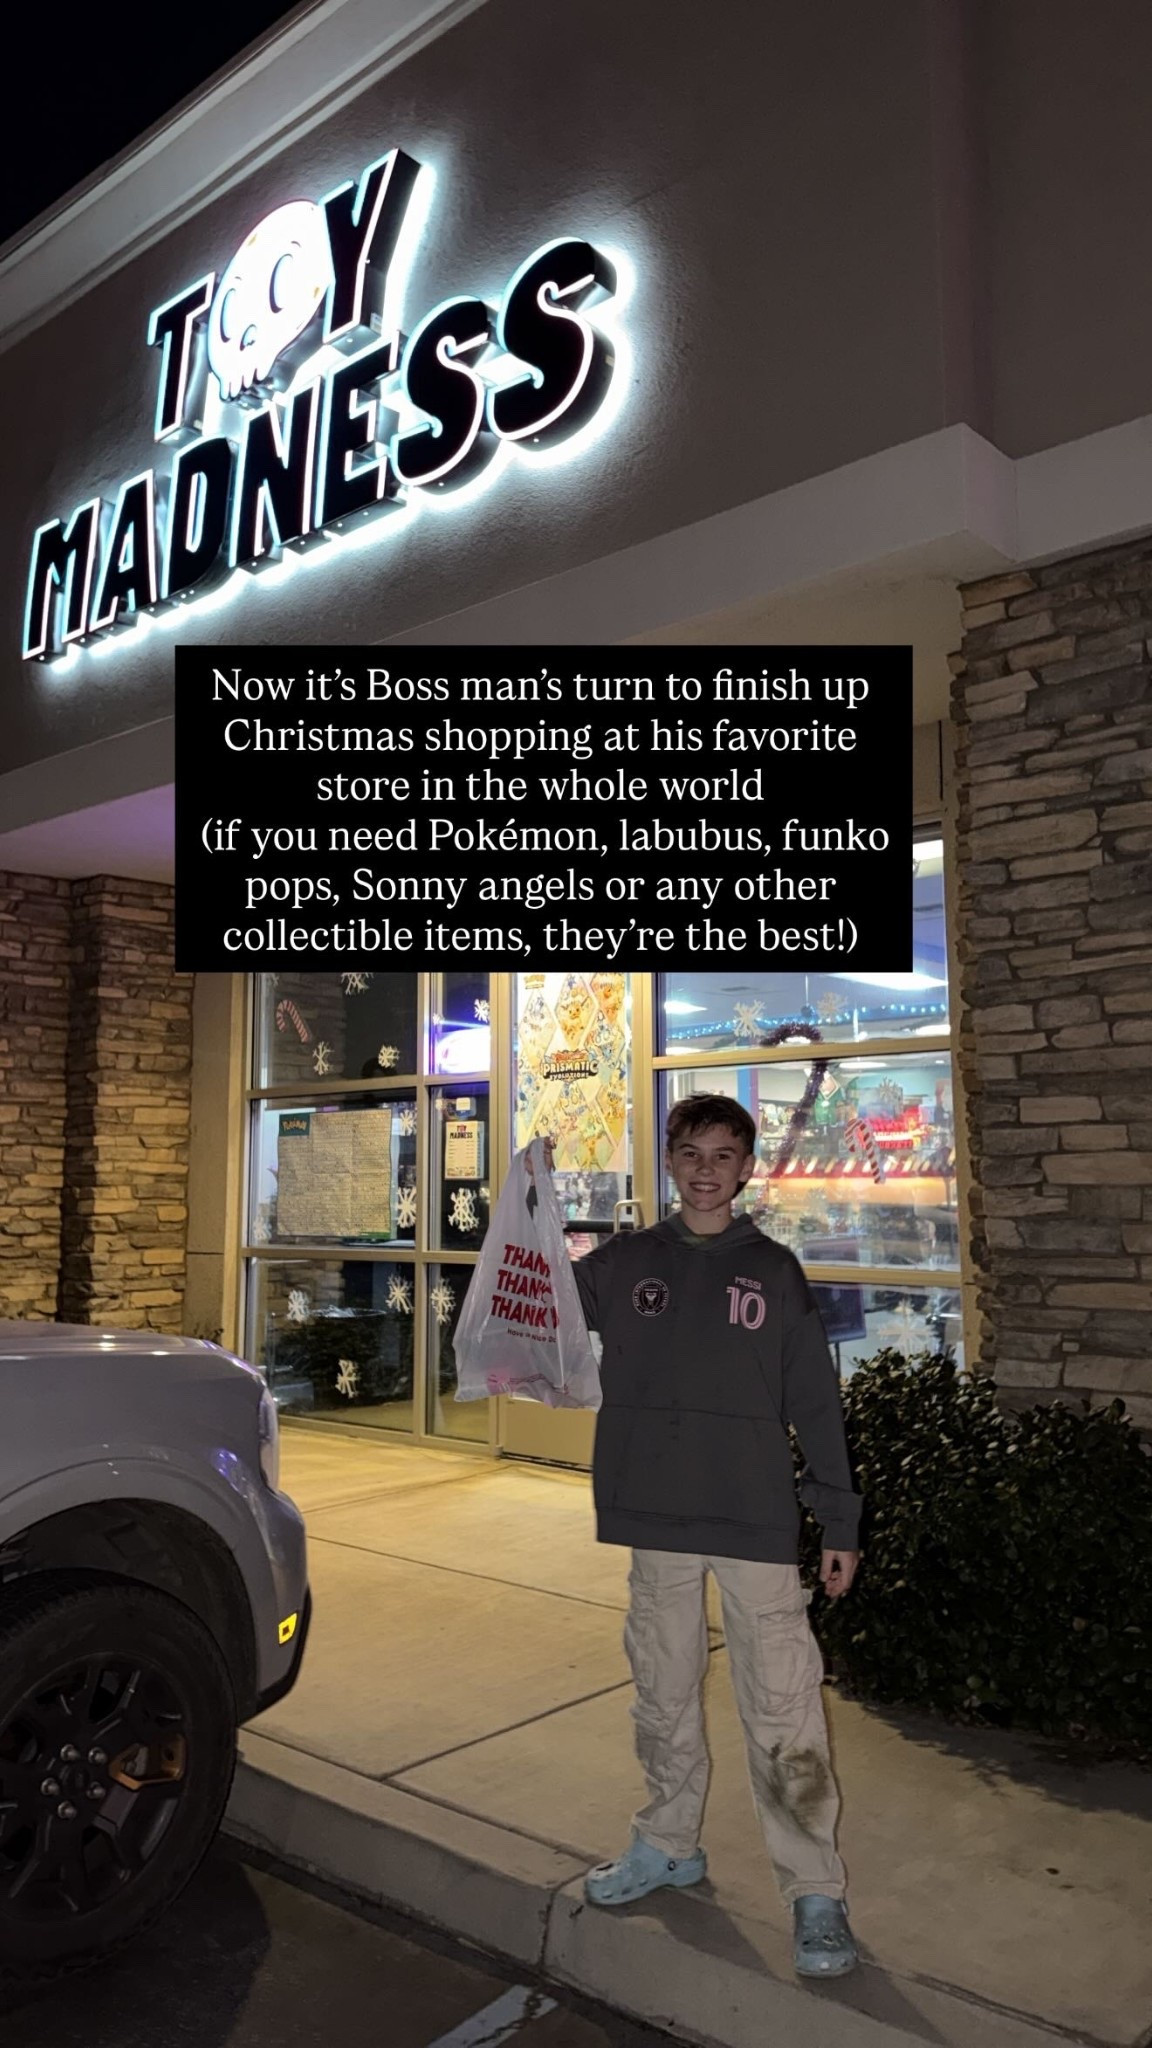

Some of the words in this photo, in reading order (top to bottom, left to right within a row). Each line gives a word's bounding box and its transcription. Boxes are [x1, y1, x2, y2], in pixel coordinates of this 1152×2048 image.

[22, 237, 617, 660] MADNESS
[543, 1060, 599, 1078] PRISMATIC
[450, 1132, 473, 1140] MADNESS
[734, 1276, 763, 1292] MESSI
[490, 1294, 549, 1329] THANK
[726, 1286, 766, 1330] 10
